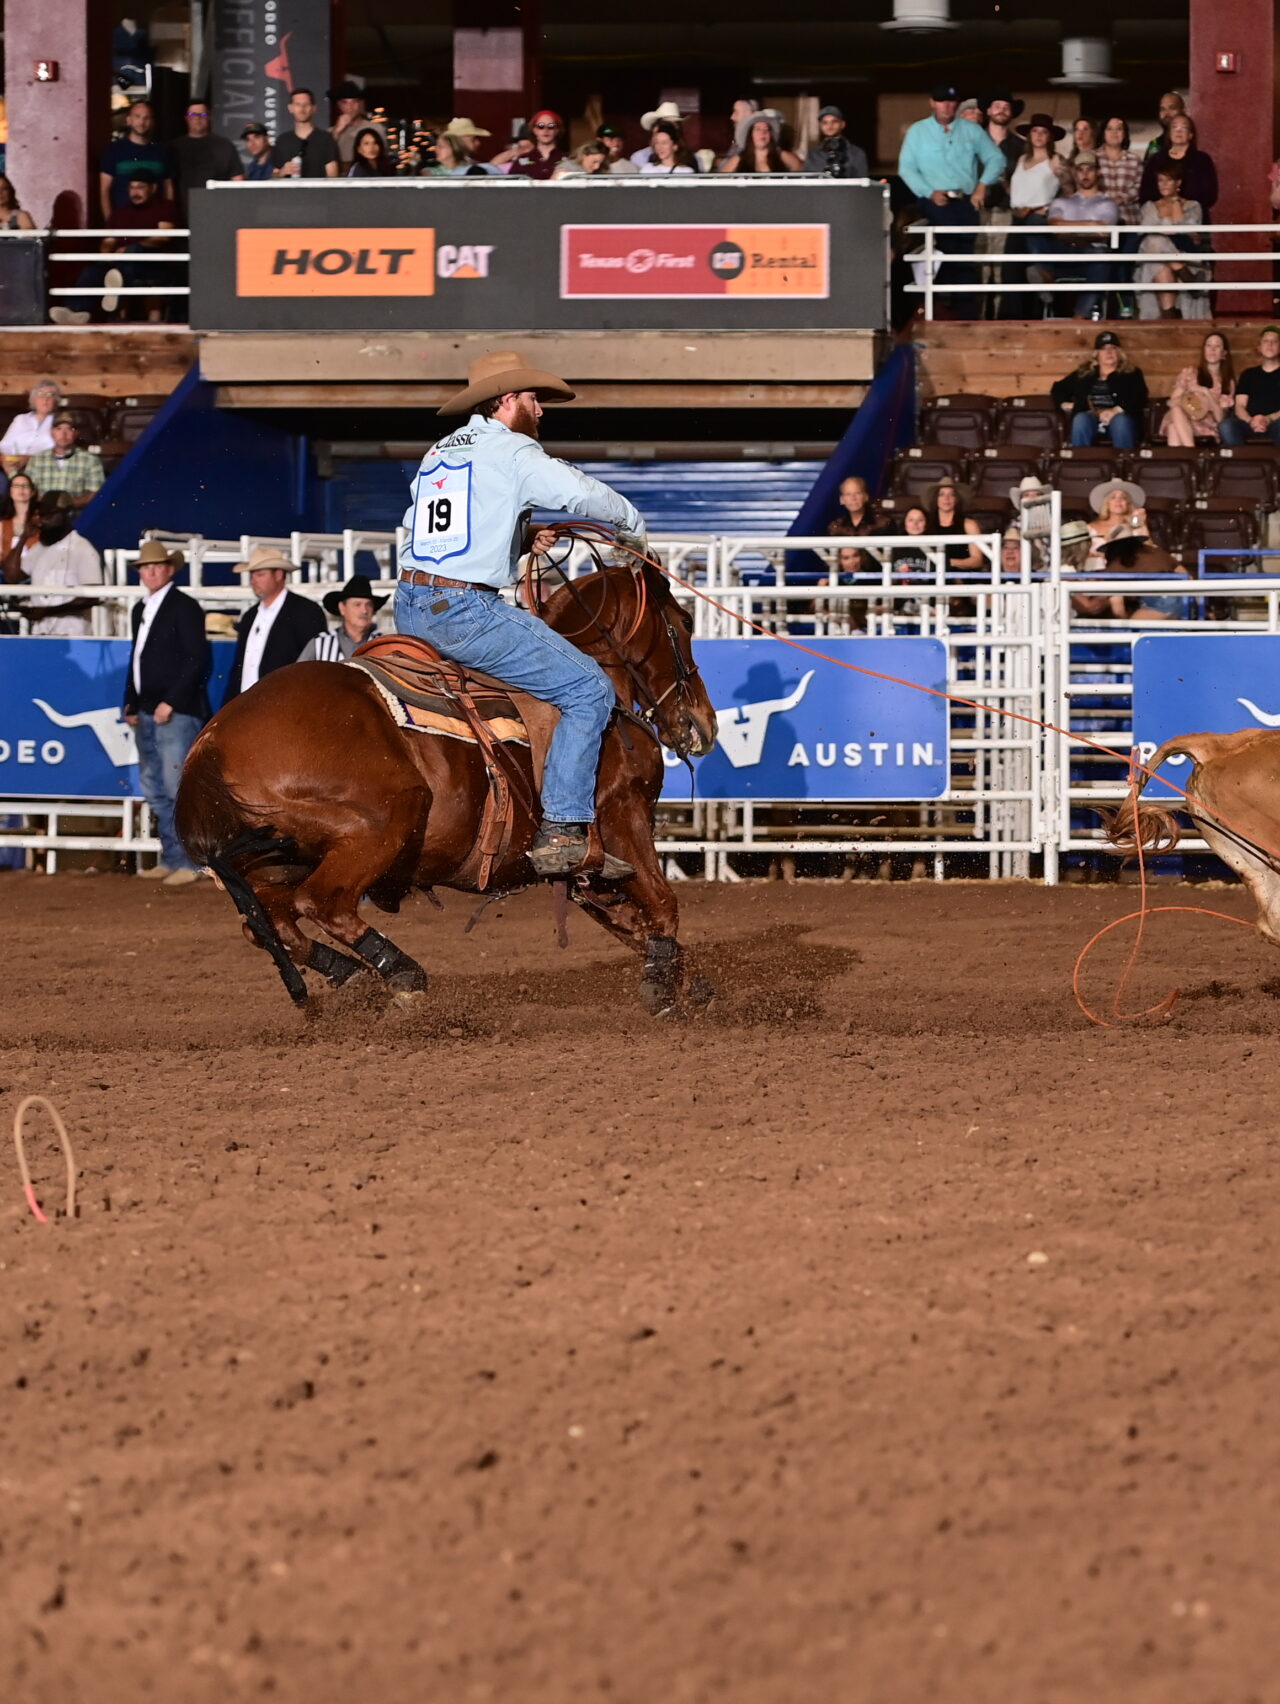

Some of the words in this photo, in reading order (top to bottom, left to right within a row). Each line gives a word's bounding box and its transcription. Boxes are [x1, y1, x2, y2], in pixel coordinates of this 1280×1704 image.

[224, 0, 254, 127] FFICIAL
[272, 249, 415, 275] HOLT
[437, 245, 495, 278] CAT
[578, 253, 624, 268] Texas
[655, 253, 695, 268] First
[712, 252, 742, 269] CAT
[751, 253, 816, 268] Rental
[435, 428, 478, 449] Classic
[427, 498, 451, 534] 19
[430, 544, 447, 553] 2023
[788, 742, 933, 767] AUSTIN
